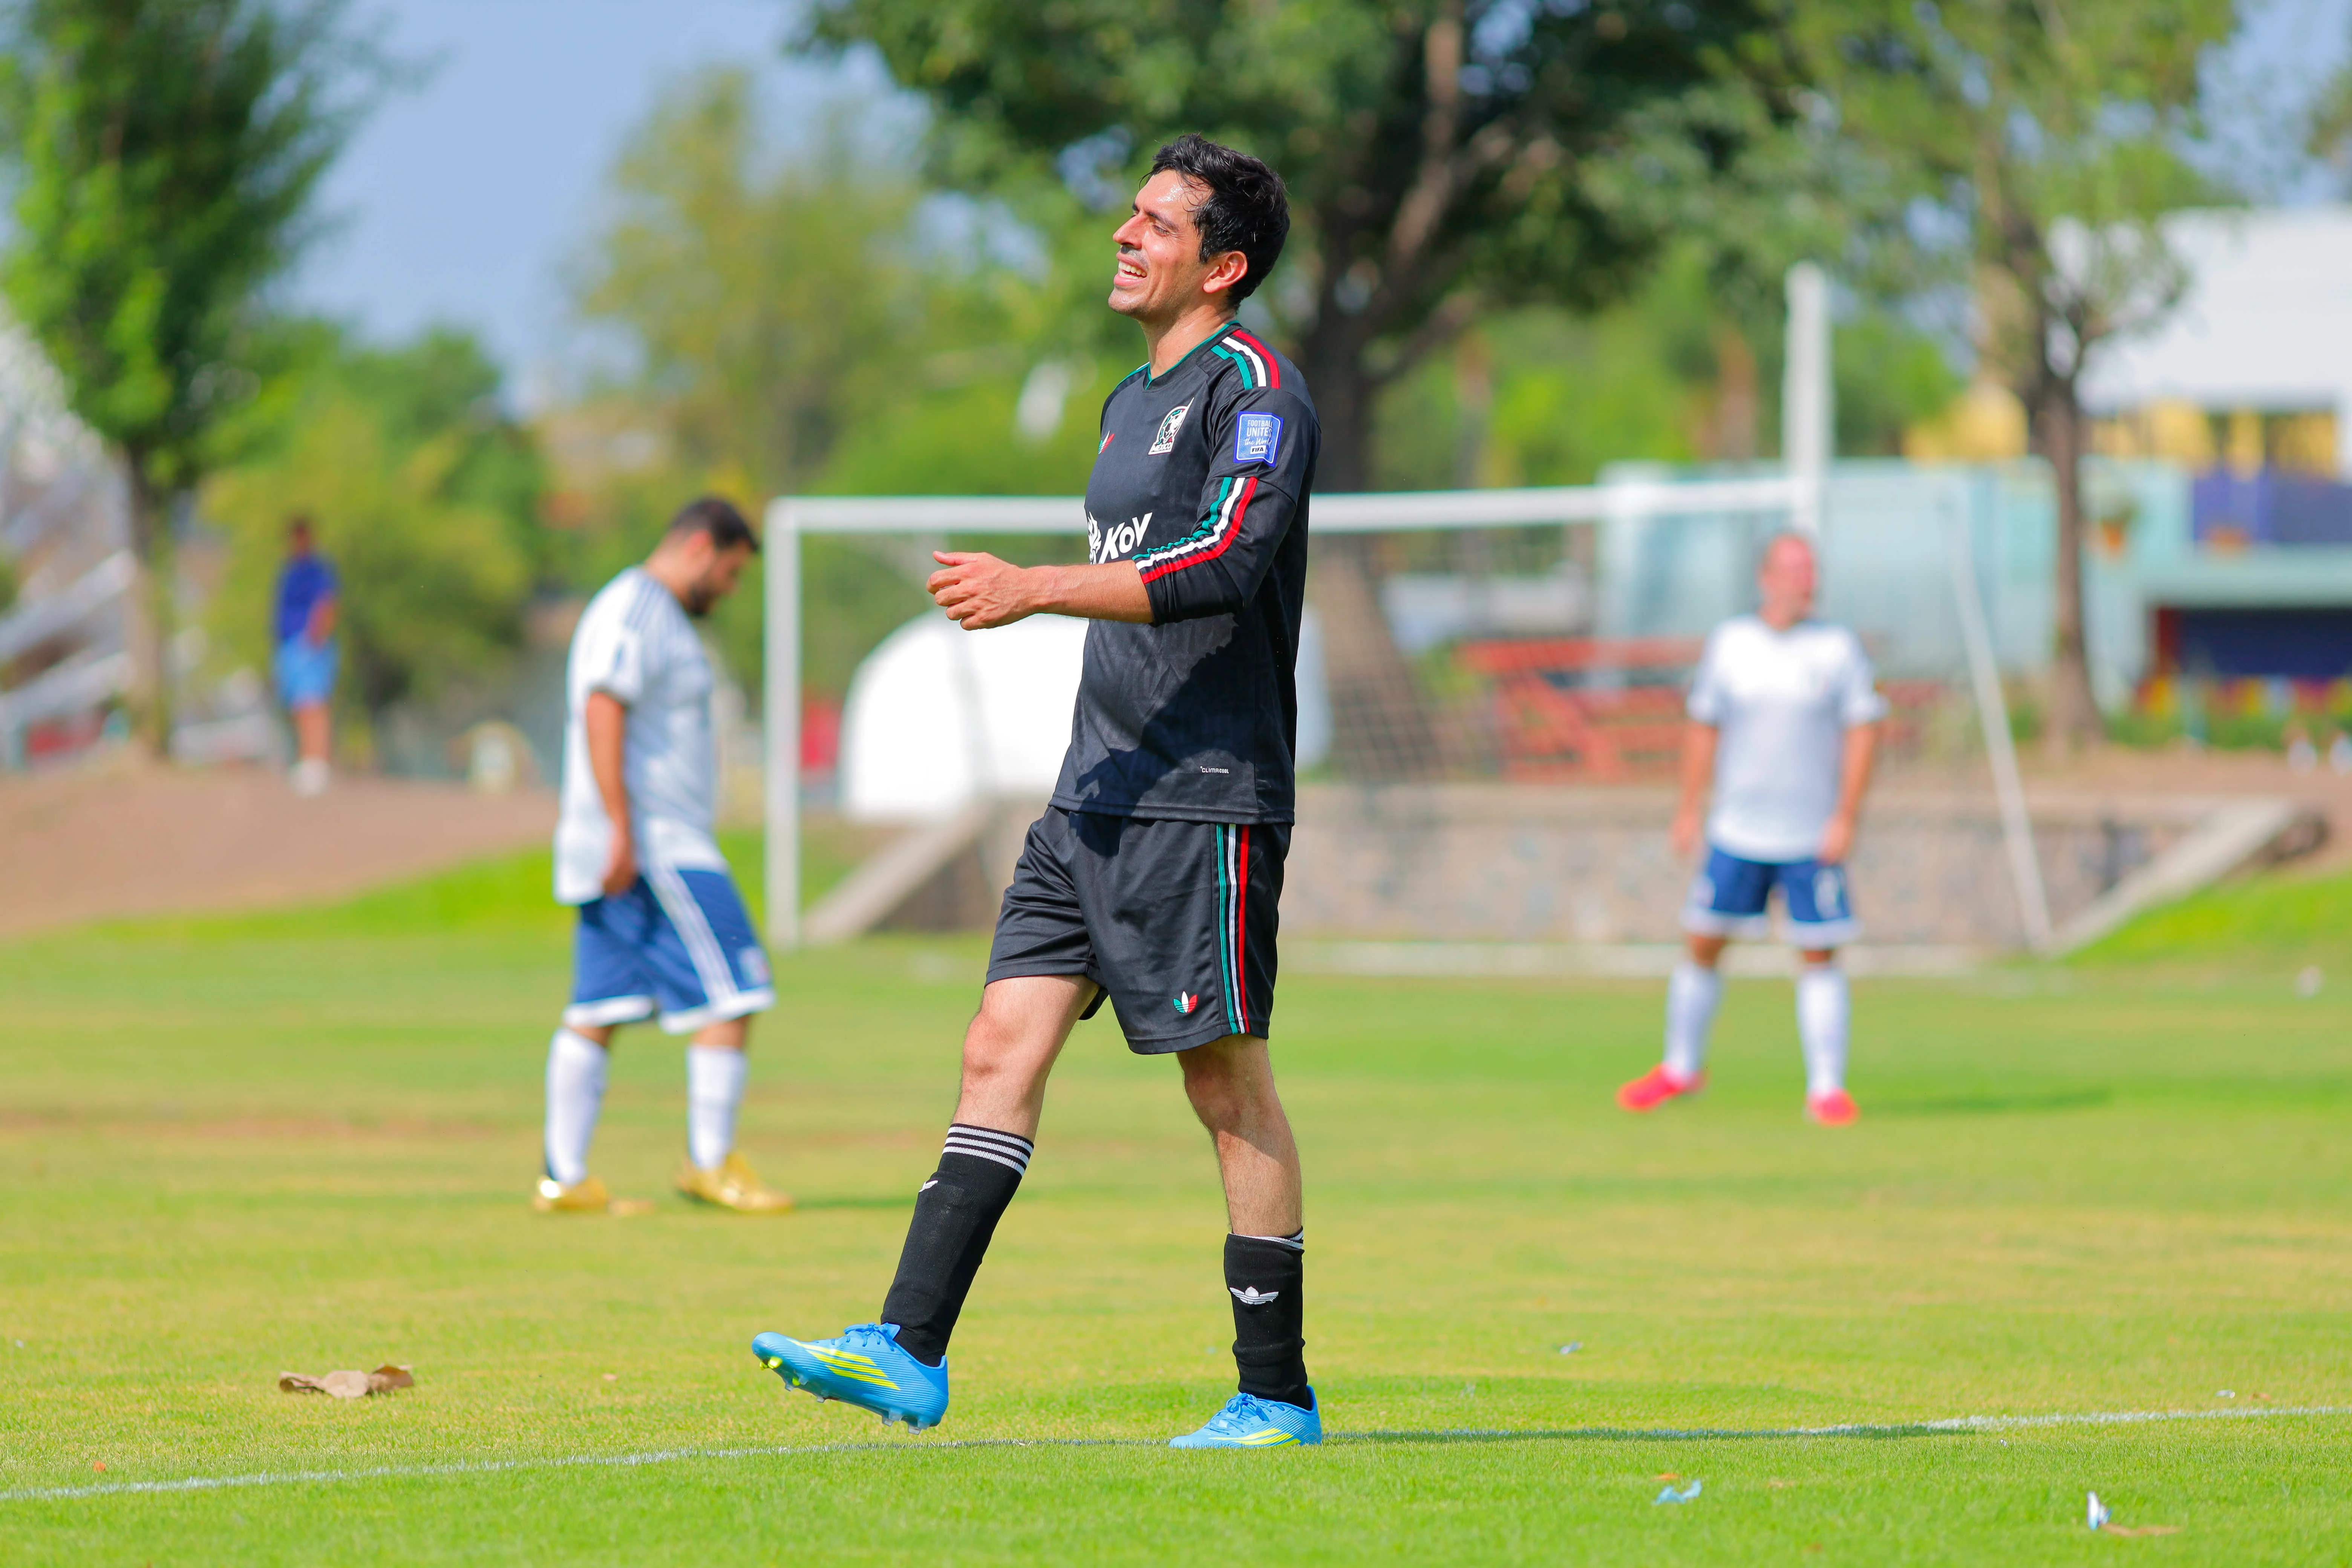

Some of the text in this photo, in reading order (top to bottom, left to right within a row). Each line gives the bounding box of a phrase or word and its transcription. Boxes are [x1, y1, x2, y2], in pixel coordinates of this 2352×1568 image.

[1248, 420, 1273, 429] FOOTBALL
[1247, 427, 1272, 438] UNITES
[1245, 437, 1272, 447] the World
